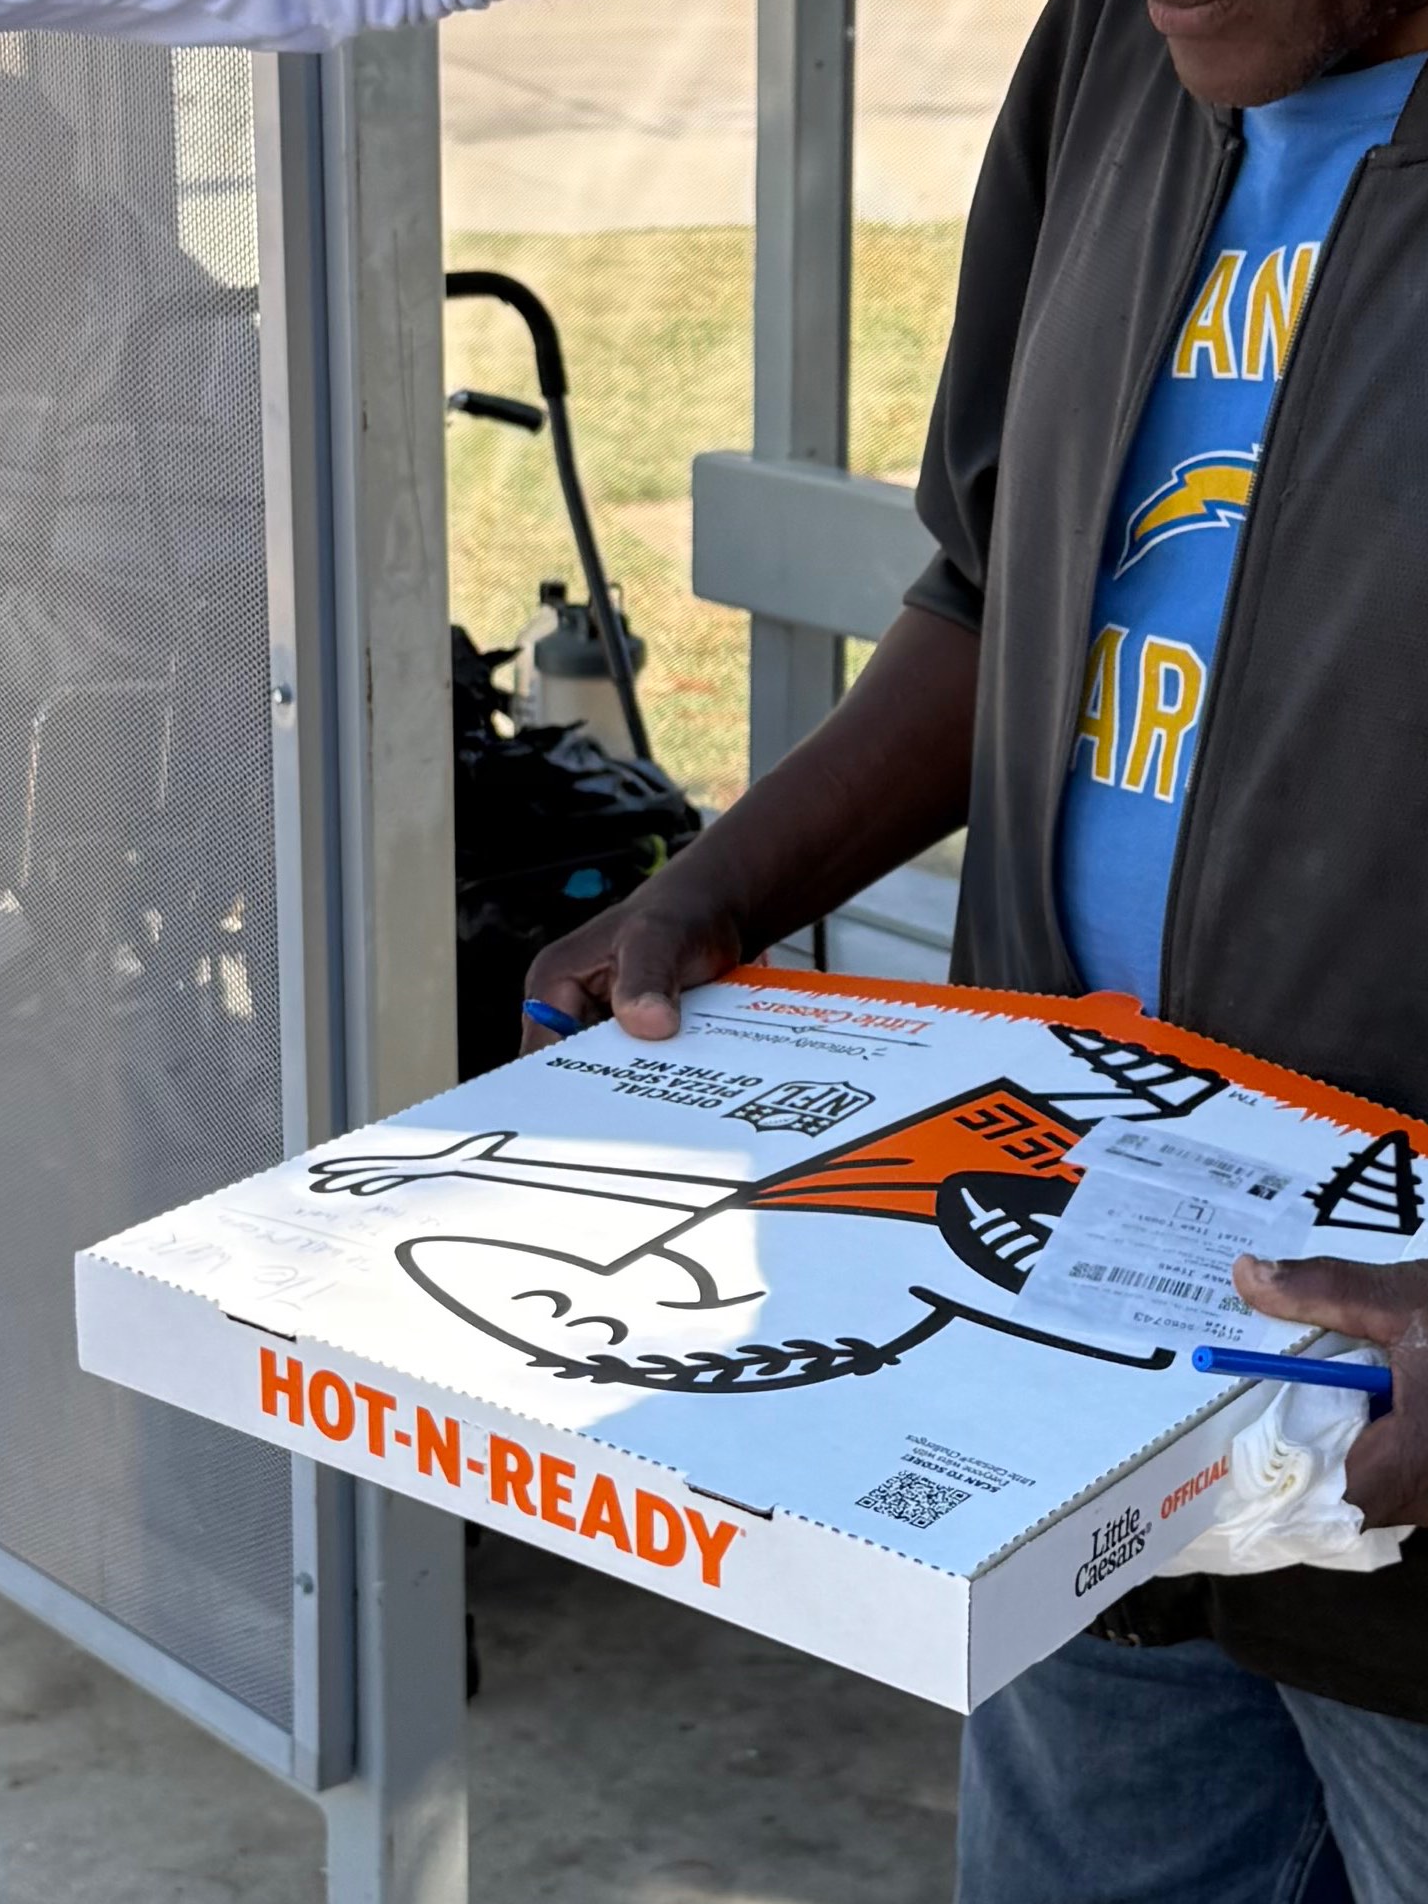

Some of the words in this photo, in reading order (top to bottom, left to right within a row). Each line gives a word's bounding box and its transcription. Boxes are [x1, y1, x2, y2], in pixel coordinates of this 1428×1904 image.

[546, 1057, 660, 1086] SPONSOR
[629, 1057, 675, 1072] NFL
[611, 1081, 722, 1110] OFFICIAL
[667, 1076, 743, 1099] PIZZA
[775, 1084, 862, 1117] NFL
[259, 1347, 740, 1589] HOT-N-READY
[966, 1476, 1001, 1493] SCAN
[1160, 1456, 1229, 1520] OFFICIAL
[1091, 1505, 1140, 1564] Little
